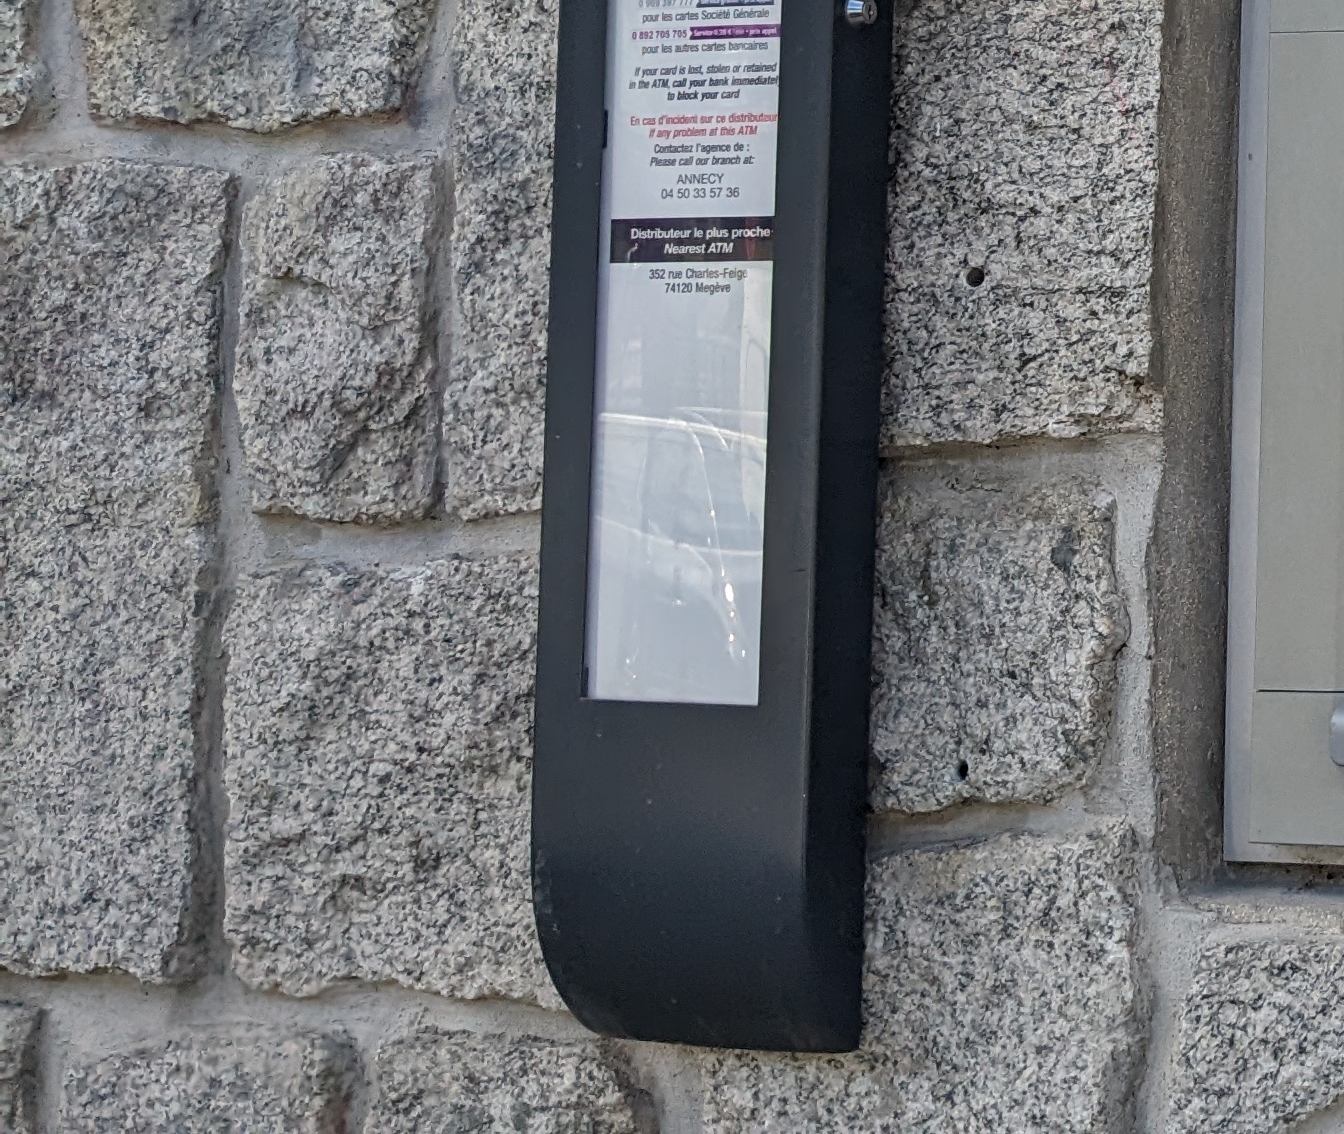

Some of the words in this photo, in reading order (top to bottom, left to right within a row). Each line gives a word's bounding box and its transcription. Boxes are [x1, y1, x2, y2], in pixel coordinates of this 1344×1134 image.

[642, 13, 660, 23] pour
[662, 12, 673, 21] les
[675, 11, 699, 21] cartes
[701, 9, 730, 20] Société
[733, 8, 769, 19] Générale
[642, 45, 659, 55] pour
[662, 43, 672, 53] les
[675, 43, 699, 53] autres
[701, 42, 725, 52] cartes
[729, 41, 768, 51] bancaires
[641, 67, 658, 77] your
[660, 66, 677, 75] card
[679, 65, 686, 74] is
[688, 65, 703, 75] lost,
[706, 64, 730, 73] stolen
[733, 65, 741, 73] or
[743, 62, 777, 72] retained
[629, 81, 636, 89] in
[638, 80, 649, 88] the
[651, 78, 670, 88] ATM,
[672, 78, 687, 87] call
[689, 78, 706, 89] your
[709, 77, 728, 86] bank
[667, 92, 675, 100] to
[677, 91, 698, 100] block
[701, 91, 718, 101] your
[721, 89, 740, 99] card
[630, 116, 640, 125] En
[642, 116, 656, 125] cas
[658, 114, 697, 124] d'incident
[700, 114, 713, 123] sur
[716, 114, 725, 122] ce
[729, 111, 778, 123] distributeur
[656, 130, 671, 139] any
[673, 126, 707, 138] problem
[709, 126, 718, 136] at
[720, 126, 735, 135] this
[737, 126, 757, 135] ATM
[654, 144, 693, 154] Contactez
[696, 143, 731, 154] l'agence
[734, 142, 744, 151] de
[650, 157, 676, 166] Please
[679, 156, 693, 165] call
[696, 157, 709, 165] our
[712, 155, 741, 165] branch
[677, 173, 724, 185] ANNECY
[661, 189, 674, 199] 04
[677, 189, 690, 199] 50
[693, 188, 706, 198] 33
[710, 188, 722, 198] 57
[726, 187, 740, 197] 36
[630, 228, 691, 239] Distributeur
[693, 227, 703, 238] le
[706, 226, 729, 239] plus
[731, 225, 770, 239] proche
[664, 243, 705, 254] Nearest
[708, 242, 733, 253] ATM
[649, 269, 666, 279] 352
[668, 270, 682, 279] rue
[686, 267, 748, 280] Charles-Feige
[665, 283, 692, 294] 74120
[695, 282, 731, 295] Megève
